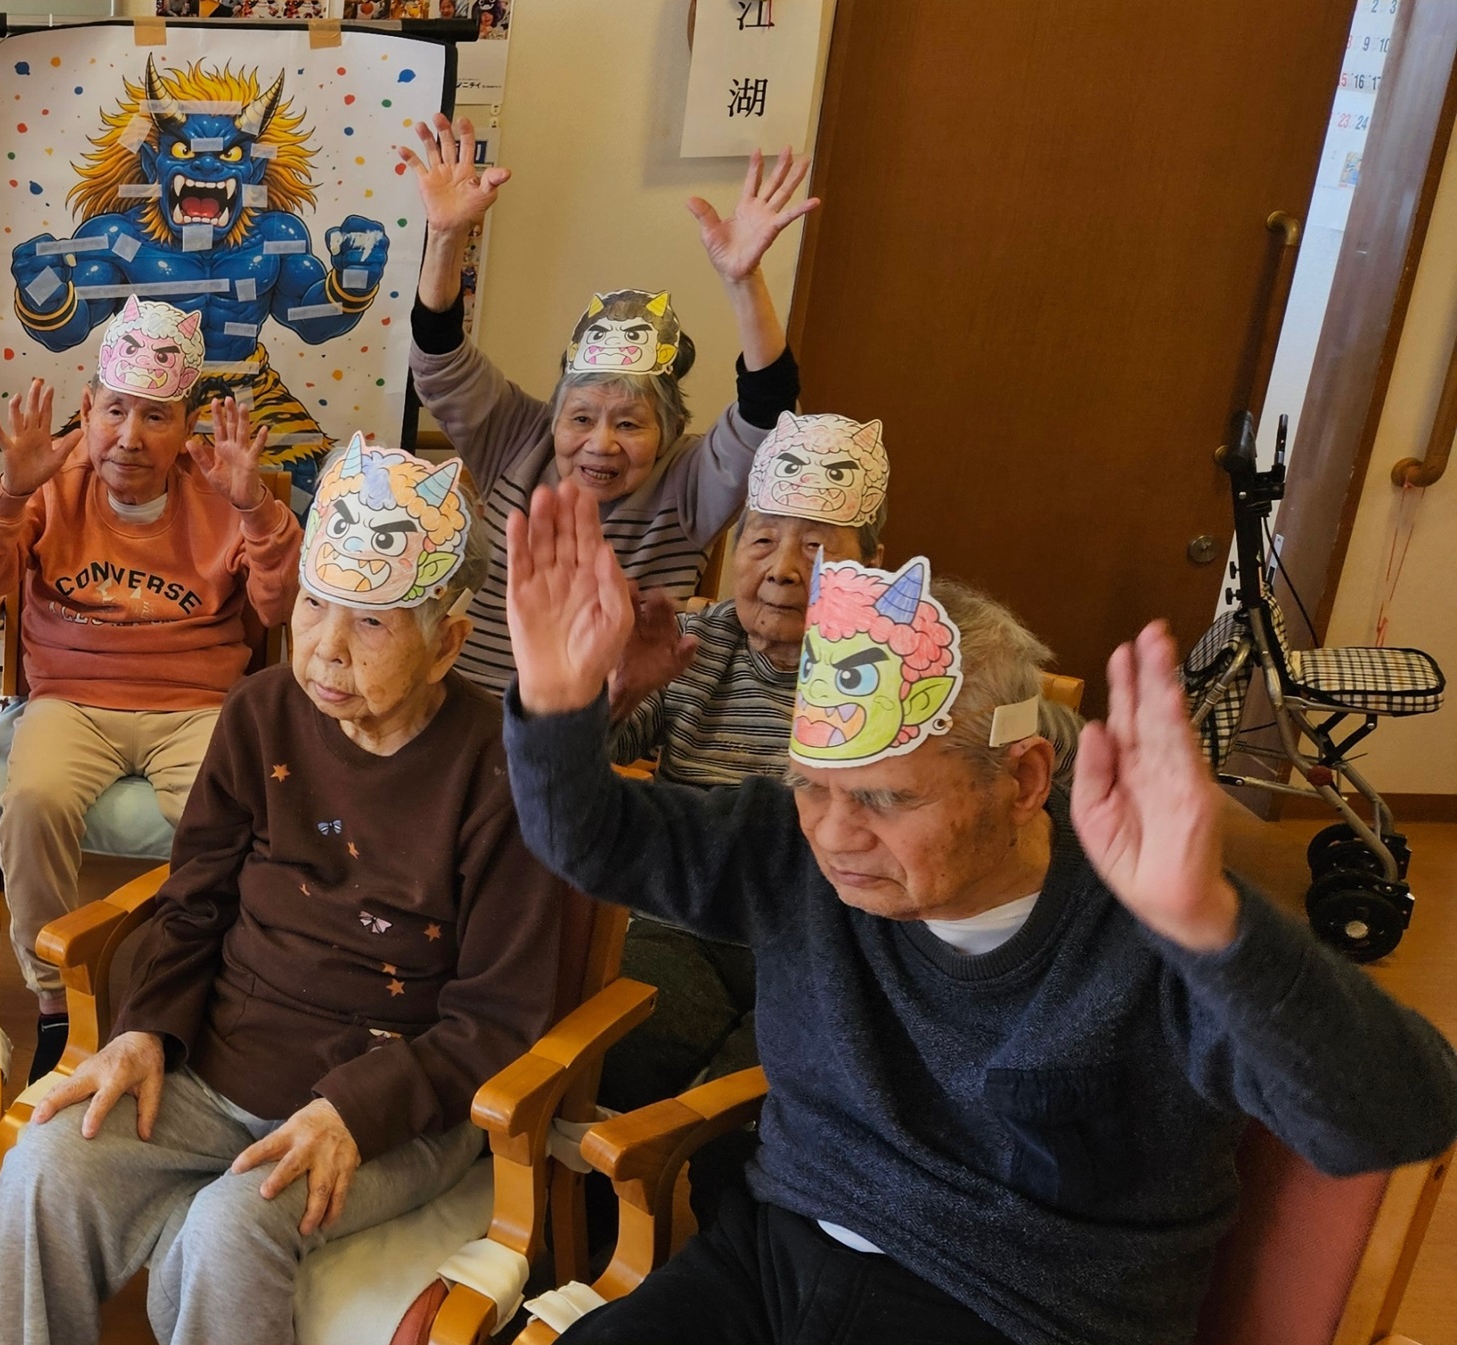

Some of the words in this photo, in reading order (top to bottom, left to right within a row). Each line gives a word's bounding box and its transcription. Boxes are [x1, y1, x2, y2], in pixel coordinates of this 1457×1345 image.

[1371, 0, 1379, 13] 2
[1390, 0, 1398, 14] 3
[1363, 36, 1371, 51] 9
[1354, 74, 1365, 89] 16
[1338, 113, 1351, 128] 23
[1354, 115, 1369, 130] 24
[55, 561, 202, 615] CONVERSE
